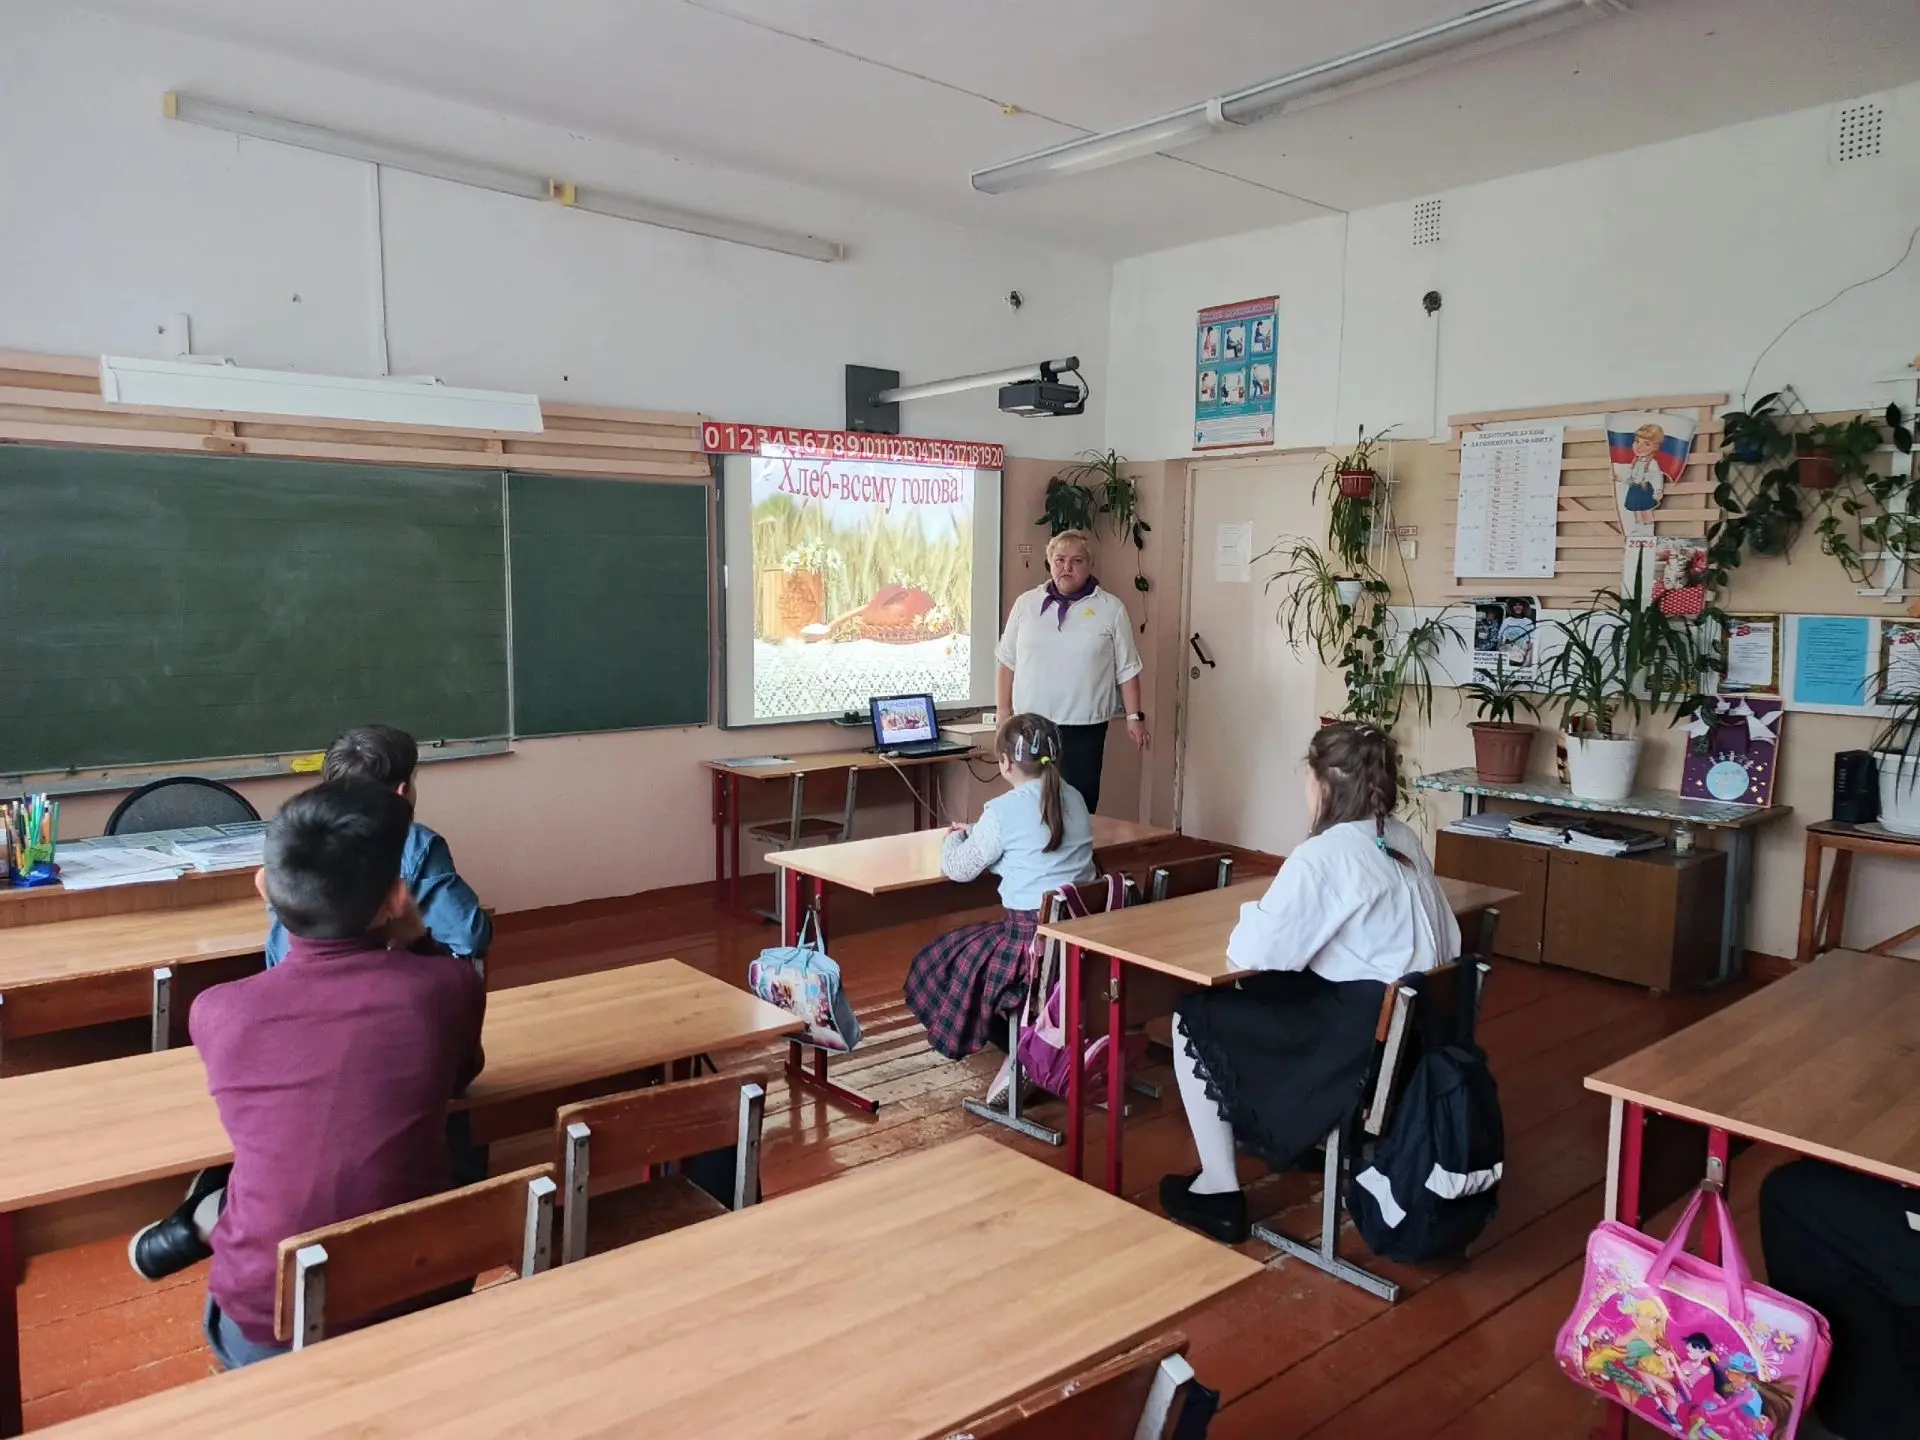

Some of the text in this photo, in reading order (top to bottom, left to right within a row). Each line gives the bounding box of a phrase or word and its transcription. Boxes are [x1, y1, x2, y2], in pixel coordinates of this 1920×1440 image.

[705, 427, 720, 448] 0
[726, 428, 735, 448] 1
[740, 428, 754, 449] 2
[804, 433, 816, 454] 6
[818, 434, 829, 454] 7
[832, 434, 844, 454] 8
[847, 436, 859, 456] 9
[860, 437, 874, 457] 10
[875, 438, 888, 458] 11
[889, 439, 902, 459] 12
[902, 440, 916, 460] 13
[916, 442, 928, 461] 14
[929, 442, 942, 462] 15
[942, 444, 954, 463] 16
[954, 445, 967, 464] 17
[968, 446, 979, 464] 18
[981, 447, 992, 466] 19
[992, 448, 1004, 466] 20
[778, 448, 896, 514] Хлеб-всему
